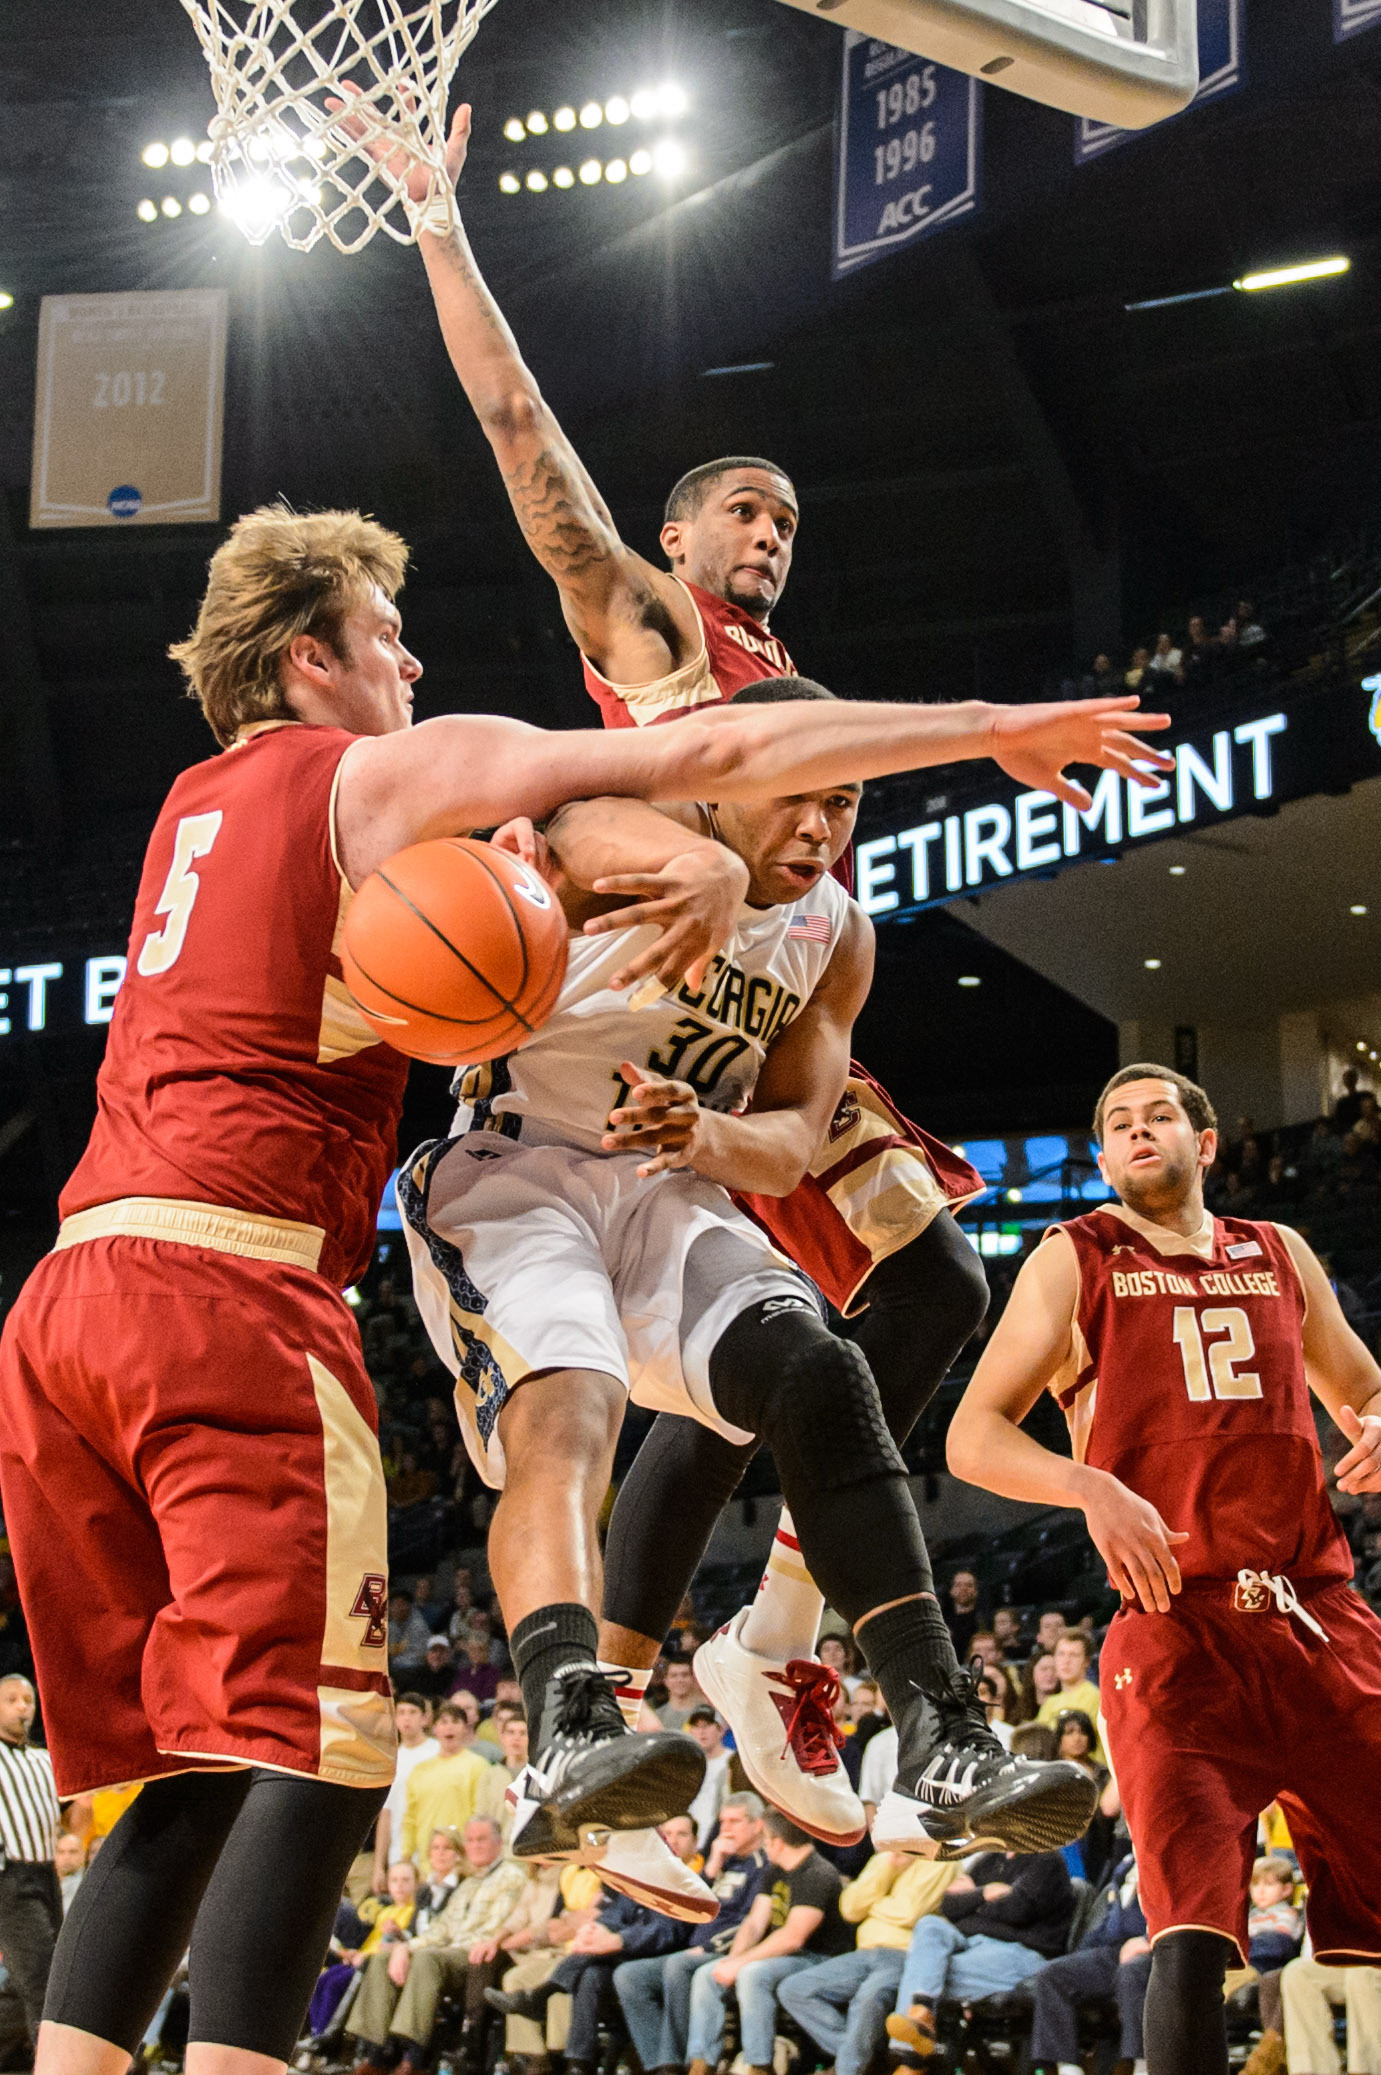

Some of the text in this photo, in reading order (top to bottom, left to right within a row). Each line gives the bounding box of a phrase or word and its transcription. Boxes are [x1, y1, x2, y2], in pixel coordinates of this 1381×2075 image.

[876, 65, 937, 129] 1985
[874, 121, 936, 185] 1996
[876, 184, 932, 234] ACC
[92, 369, 166, 407] 2012
[856, 713, 1287, 916] ETIREMENT
[137, 810, 222, 976] 5
[0, 962, 63, 1036] T
[678, 954, 800, 1043] EORGIA
[648, 1018, 750, 1093] 30
[1112, 1271, 1281, 1298] BOSTON COLLEGE
[1173, 1306, 1263, 1402] 12
